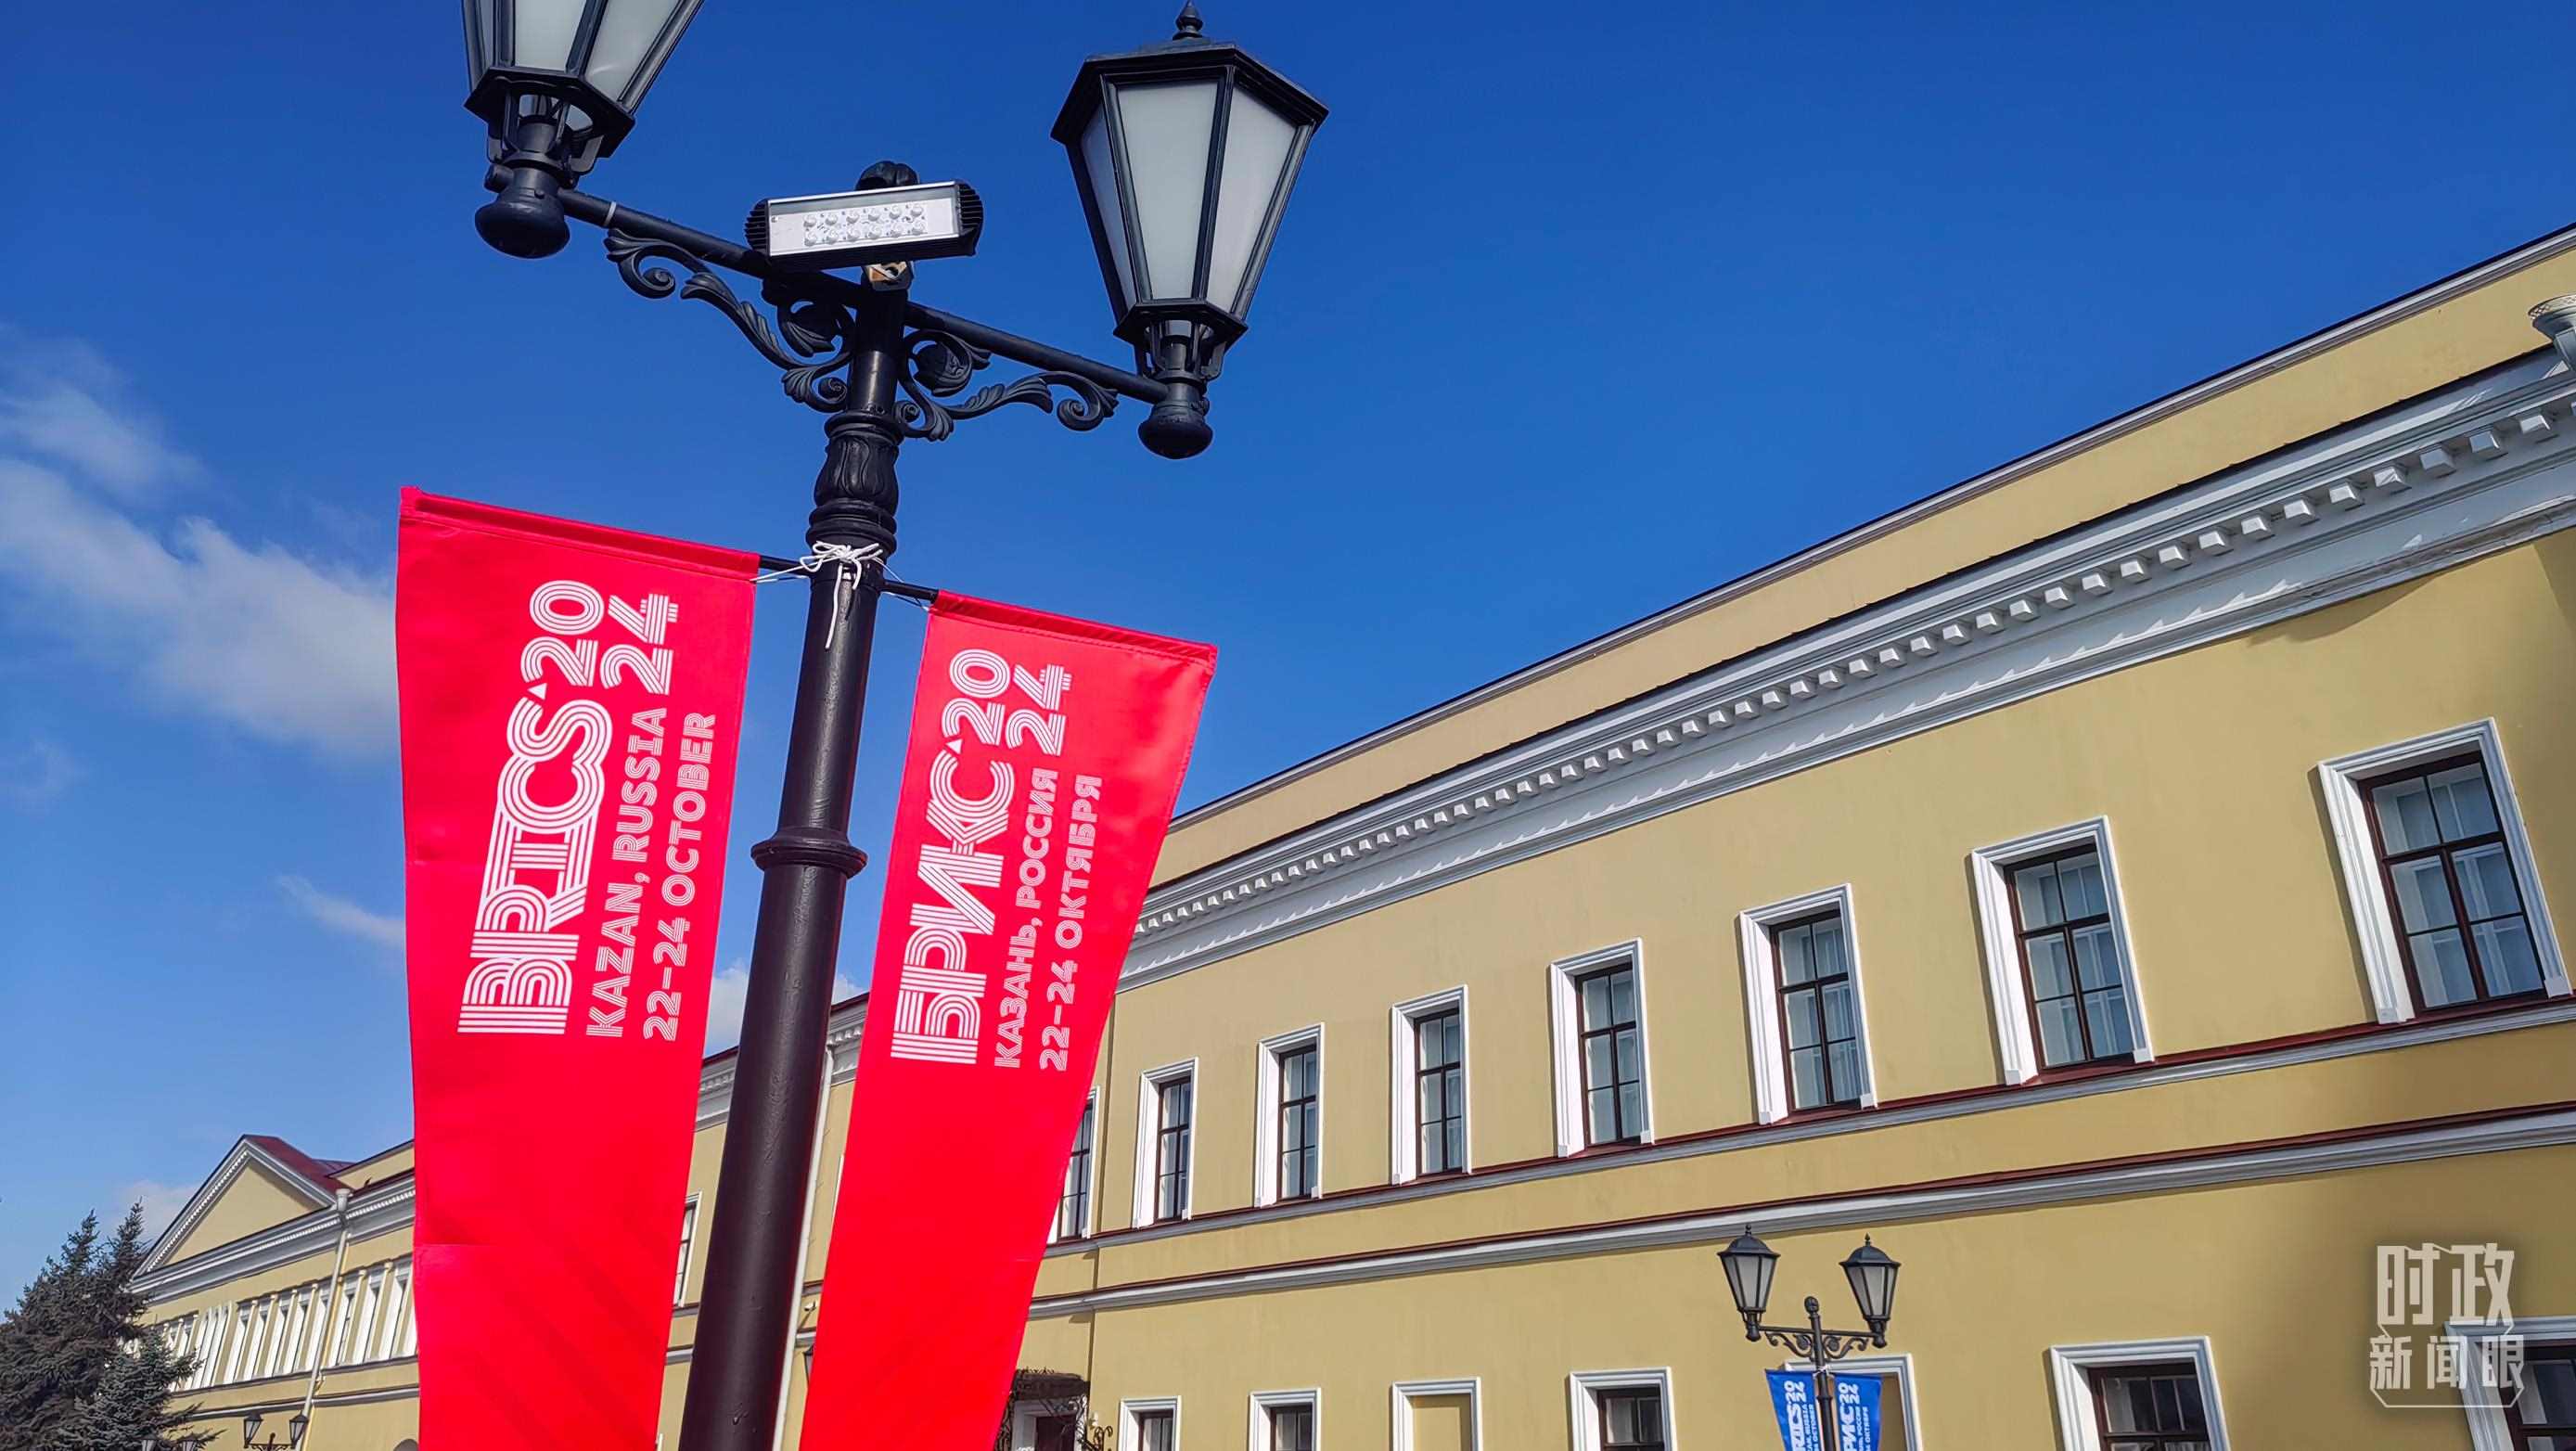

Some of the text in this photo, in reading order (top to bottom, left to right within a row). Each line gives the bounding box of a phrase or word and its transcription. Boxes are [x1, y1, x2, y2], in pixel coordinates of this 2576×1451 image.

[456, 698, 613, 1034] BRICS
[586, 708, 667, 1037] KAZAN, RUSSIA
[661, 713, 715, 906] OCTOBER
[891, 749, 1015, 1064] БРИКС
[994, 767, 1058, 1068] КАЗАНЬ, РОССИЯ
[1055, 775, 1103, 949] ОКТЯБРЯ
[1787, 1403, 1806, 1451] RICS
[1839, 1405, 1857, 1451] РИКС
